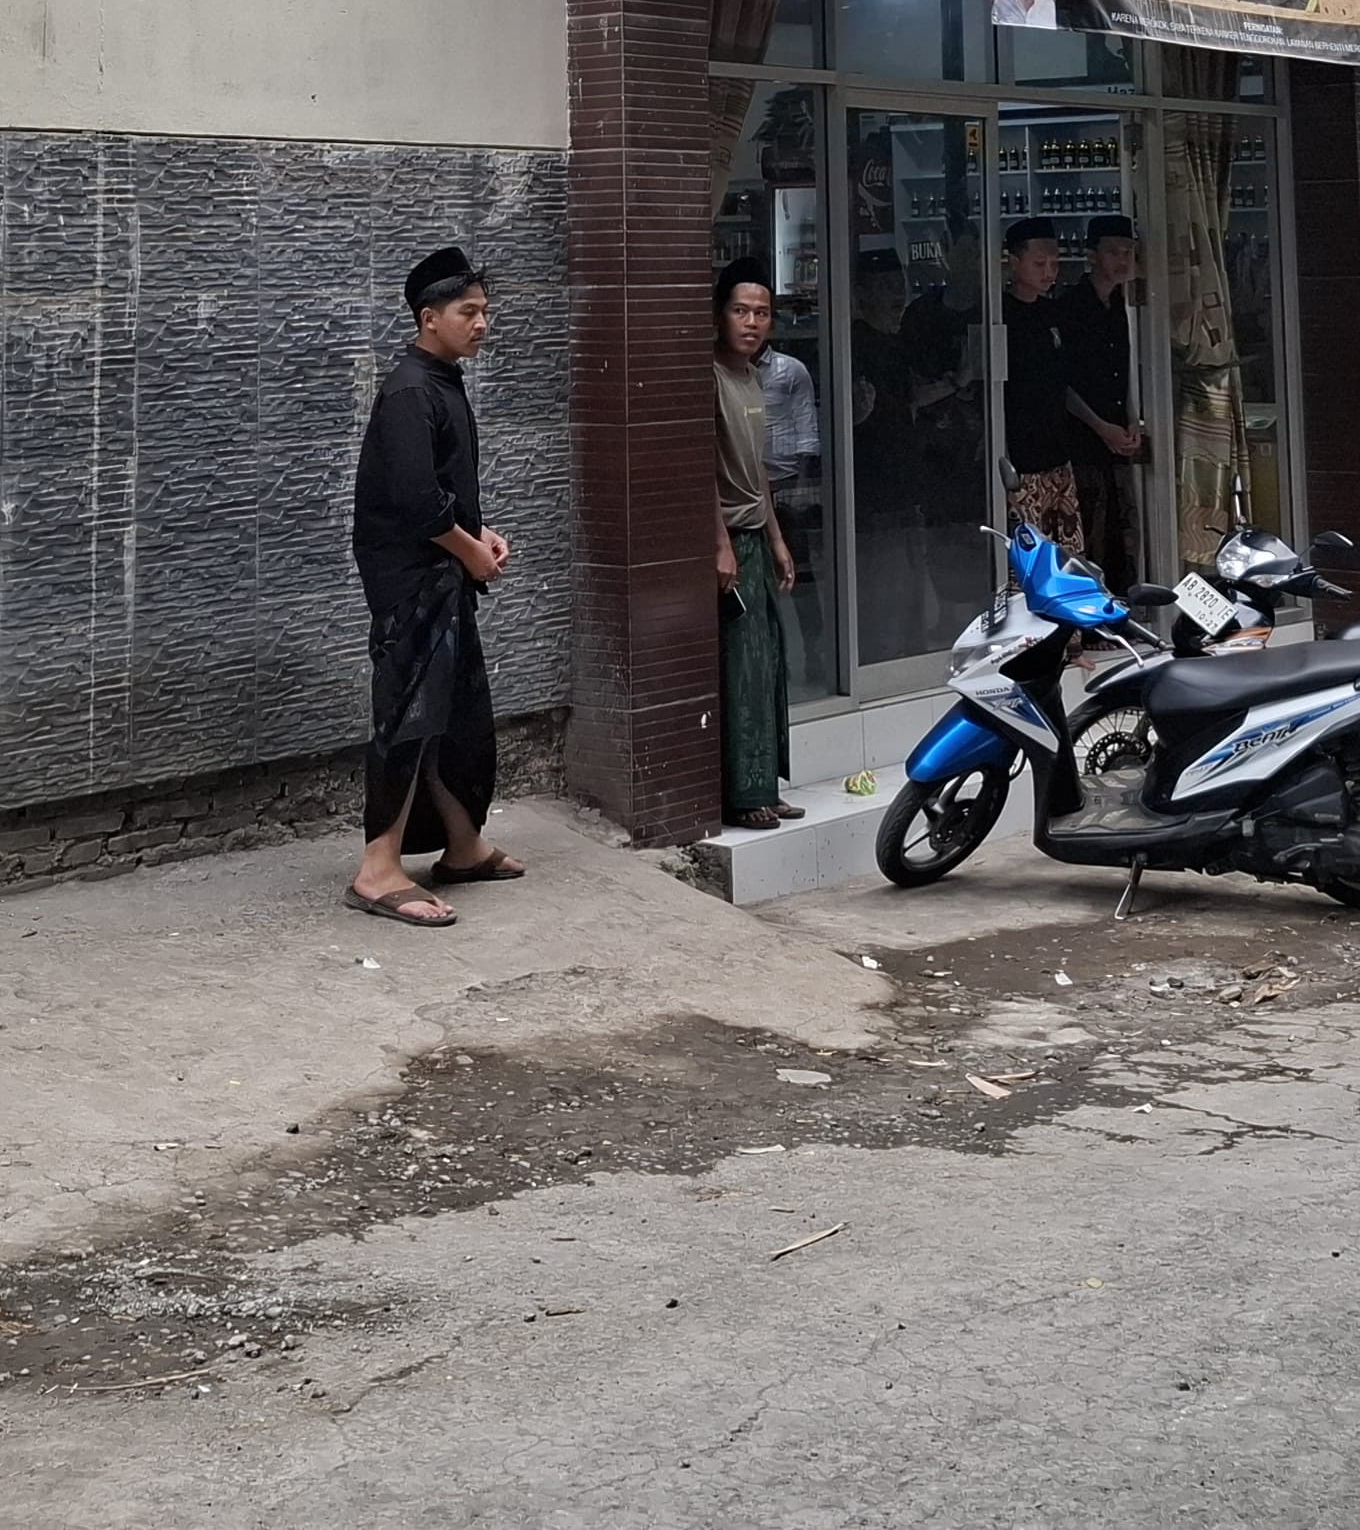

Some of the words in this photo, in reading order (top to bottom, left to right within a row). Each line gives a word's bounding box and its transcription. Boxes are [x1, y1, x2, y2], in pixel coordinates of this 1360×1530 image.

[911, 242, 943, 261] BUKA
[1182, 576, 1198, 591] AB
[1194, 587, 1219, 608] 2820
[975, 687, 1010, 696] HONDA
